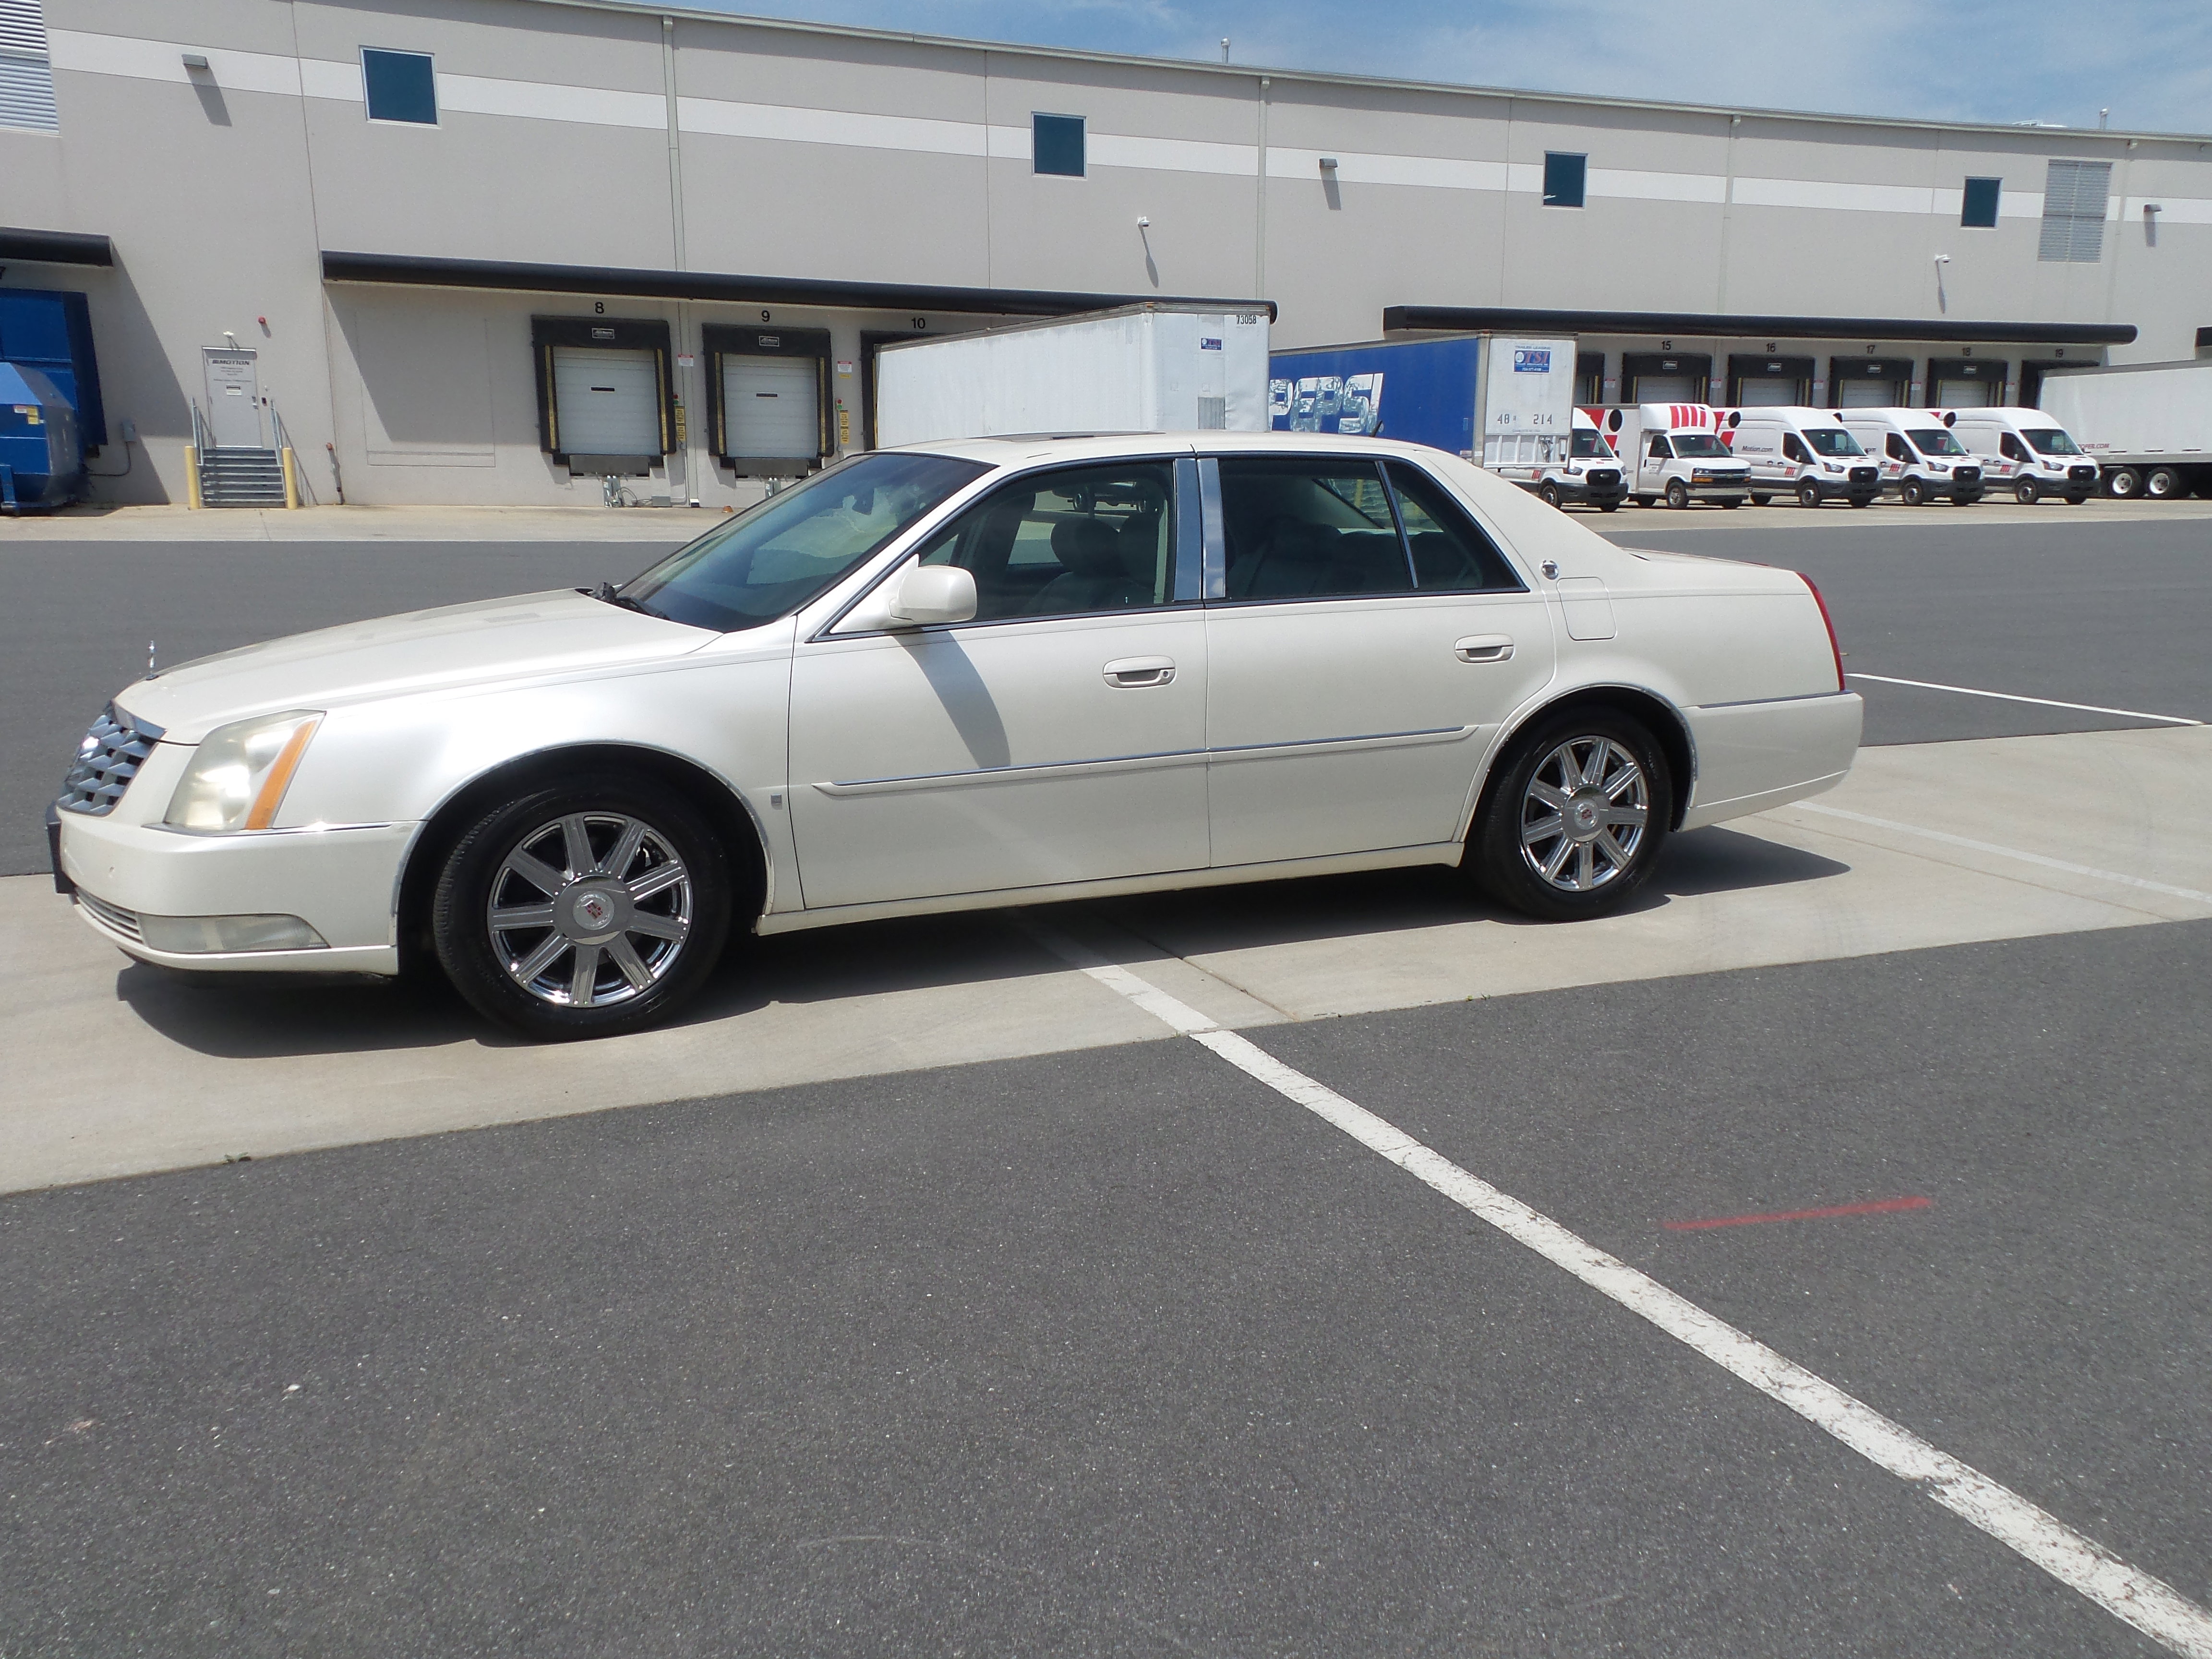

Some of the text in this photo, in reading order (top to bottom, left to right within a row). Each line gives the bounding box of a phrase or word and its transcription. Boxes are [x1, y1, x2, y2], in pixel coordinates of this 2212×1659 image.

[595, 302, 604, 314] 8
[761, 310, 770, 322] 9
[1237, 315, 1257, 325] 73058
[911, 317, 926, 329] 10
[1661, 340, 1671, 350] 15
[1766, 342, 1776, 352] 16
[1866, 345, 1875, 354] 17
[1524, 351, 1550, 363] TSI
[1961, 347, 1970, 356] 18
[2055, 349, 2063, 358] 19
[1268, 373, 1384, 434] PEPSI
[1497, 413, 1510, 424] 48
[1533, 413, 1552, 425] 214
